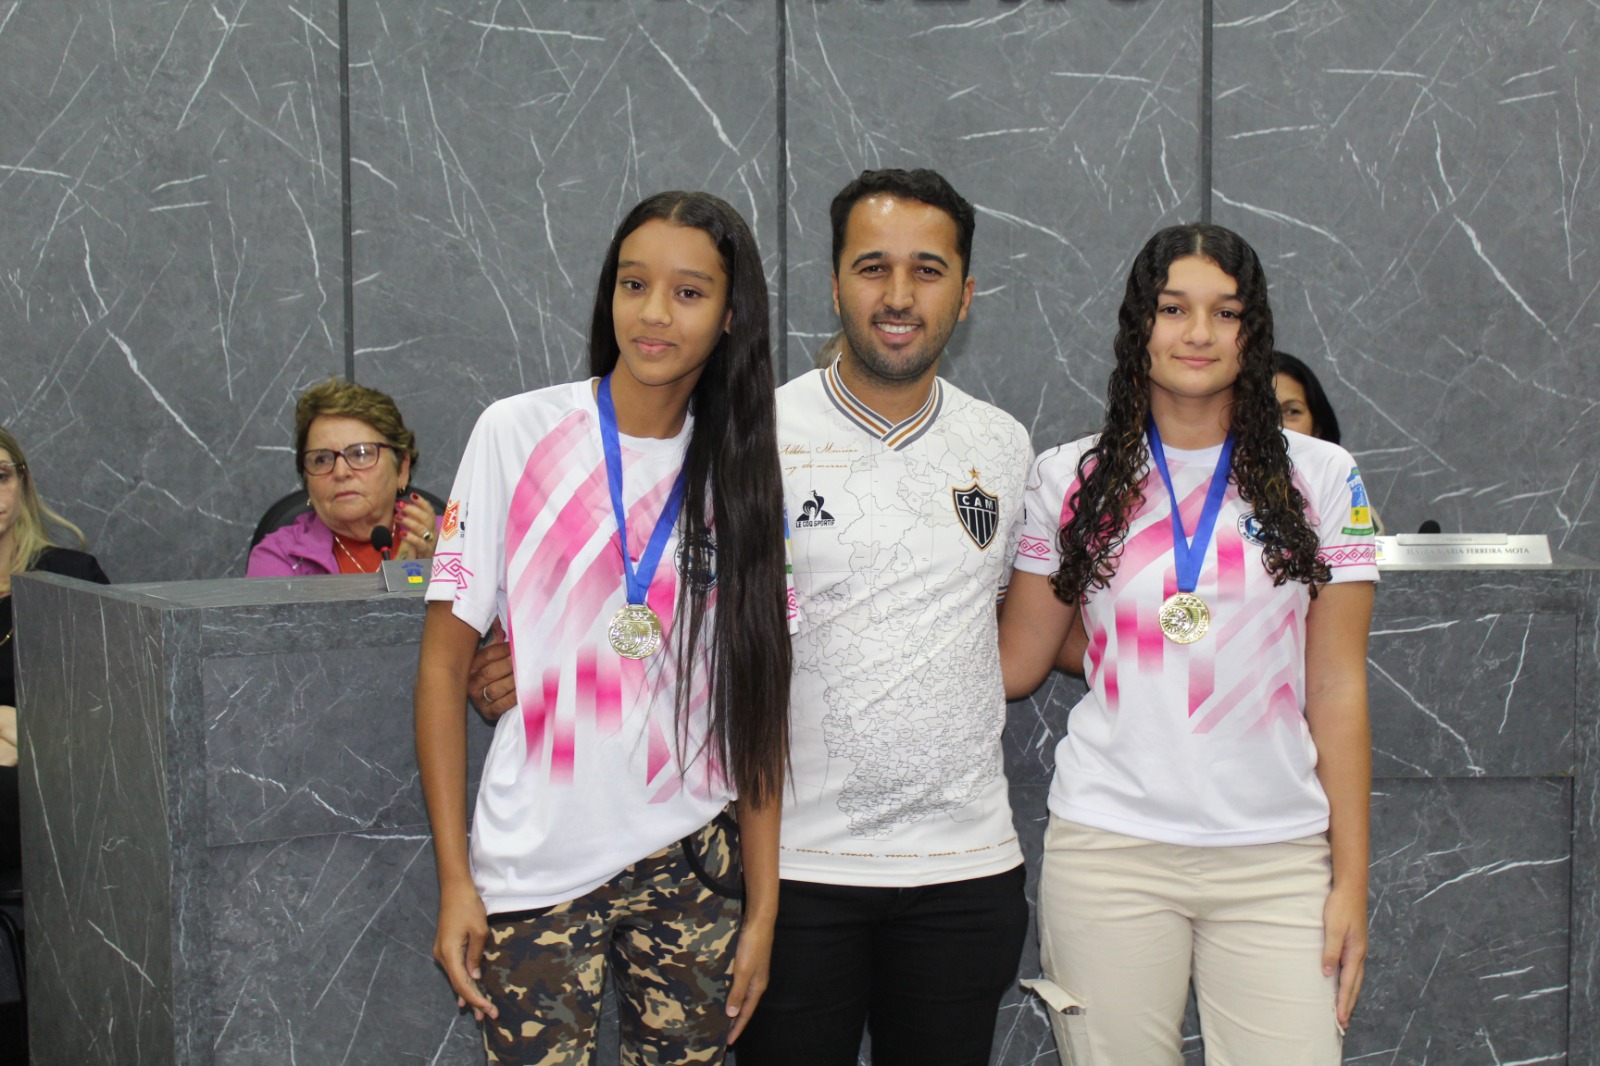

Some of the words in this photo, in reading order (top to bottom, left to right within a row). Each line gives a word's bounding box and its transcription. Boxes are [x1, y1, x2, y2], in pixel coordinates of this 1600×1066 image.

[962, 495, 993, 510] CAM
[803, 520, 813, 528] COQ
[814, 519, 835, 527] SPORTIF
[1467, 547, 1502, 555] FERREIRA
[1505, 547, 1530, 555] MOTA
